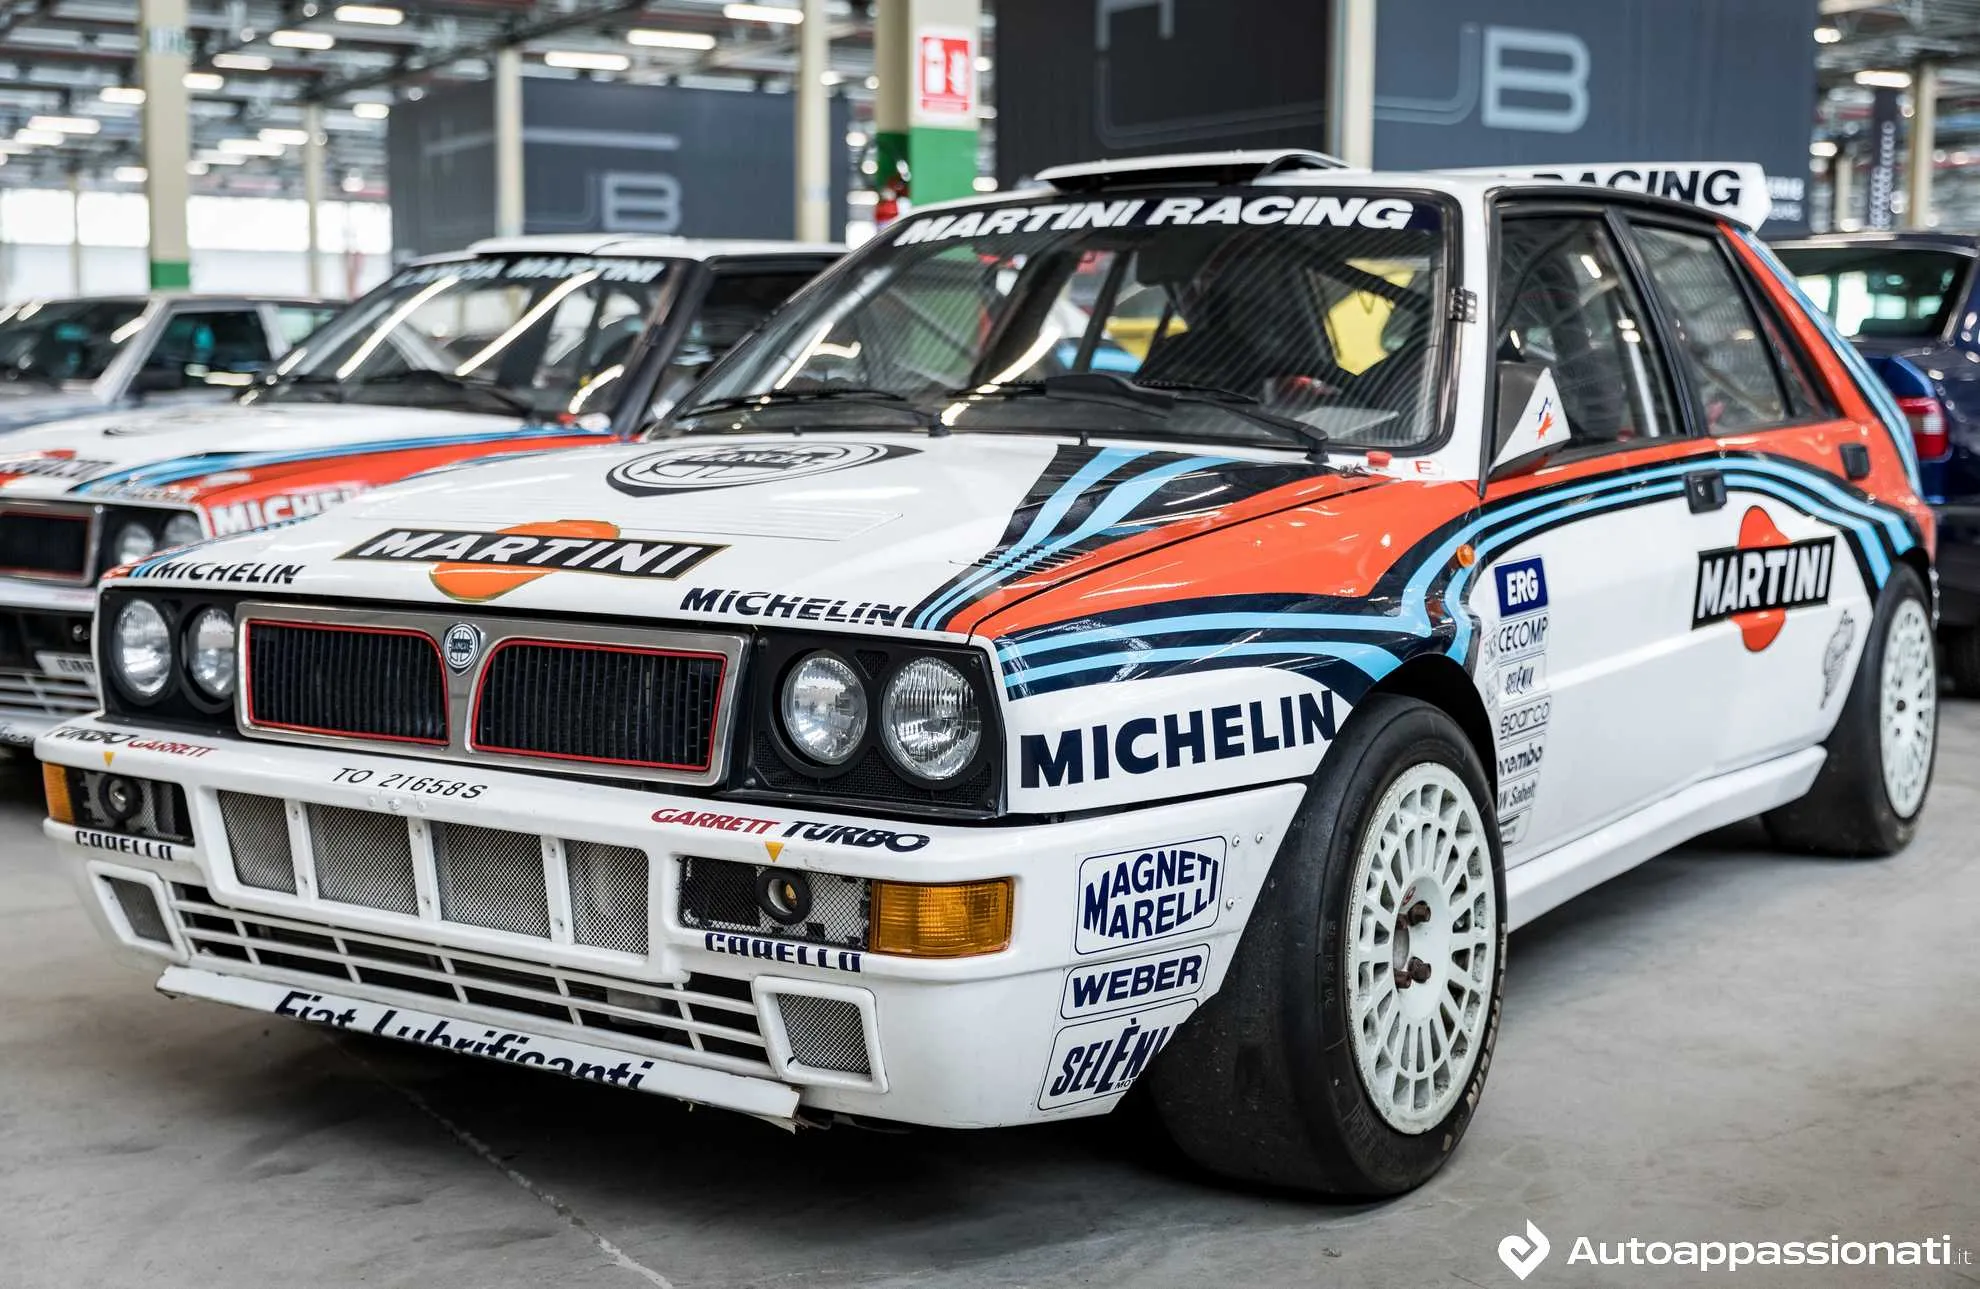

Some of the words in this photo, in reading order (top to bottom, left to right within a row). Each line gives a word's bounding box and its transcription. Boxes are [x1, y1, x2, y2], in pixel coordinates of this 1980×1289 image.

[1533, 169, 1742, 206] CING
[893, 200, 1146, 247] MARTINI
[1145, 196, 1415, 230] RACING
[153, 561, 306, 585] MICHELIN
[358, 531, 703, 574] MARTINI
[1505, 567, 1539, 606] ERG
[1697, 543, 1832, 619] MARTINI
[680, 587, 908, 627] MICHELIN
[1498, 616, 1549, 652] CECOMP
[1020, 689, 1337, 788] MICHELIN
[1500, 702, 1550, 740] sparco
[128, 740, 219, 758] GARRETT
[332, 767, 375, 784] TO
[377, 773, 489, 799] 21658S
[651, 808, 783, 834] GARRETT
[782, 820, 931, 853] TURBO
[1084, 850, 1219, 905] MAGNETI
[1084, 880, 1219, 939] MARELLI
[1072, 955, 1202, 1008] WEBER
